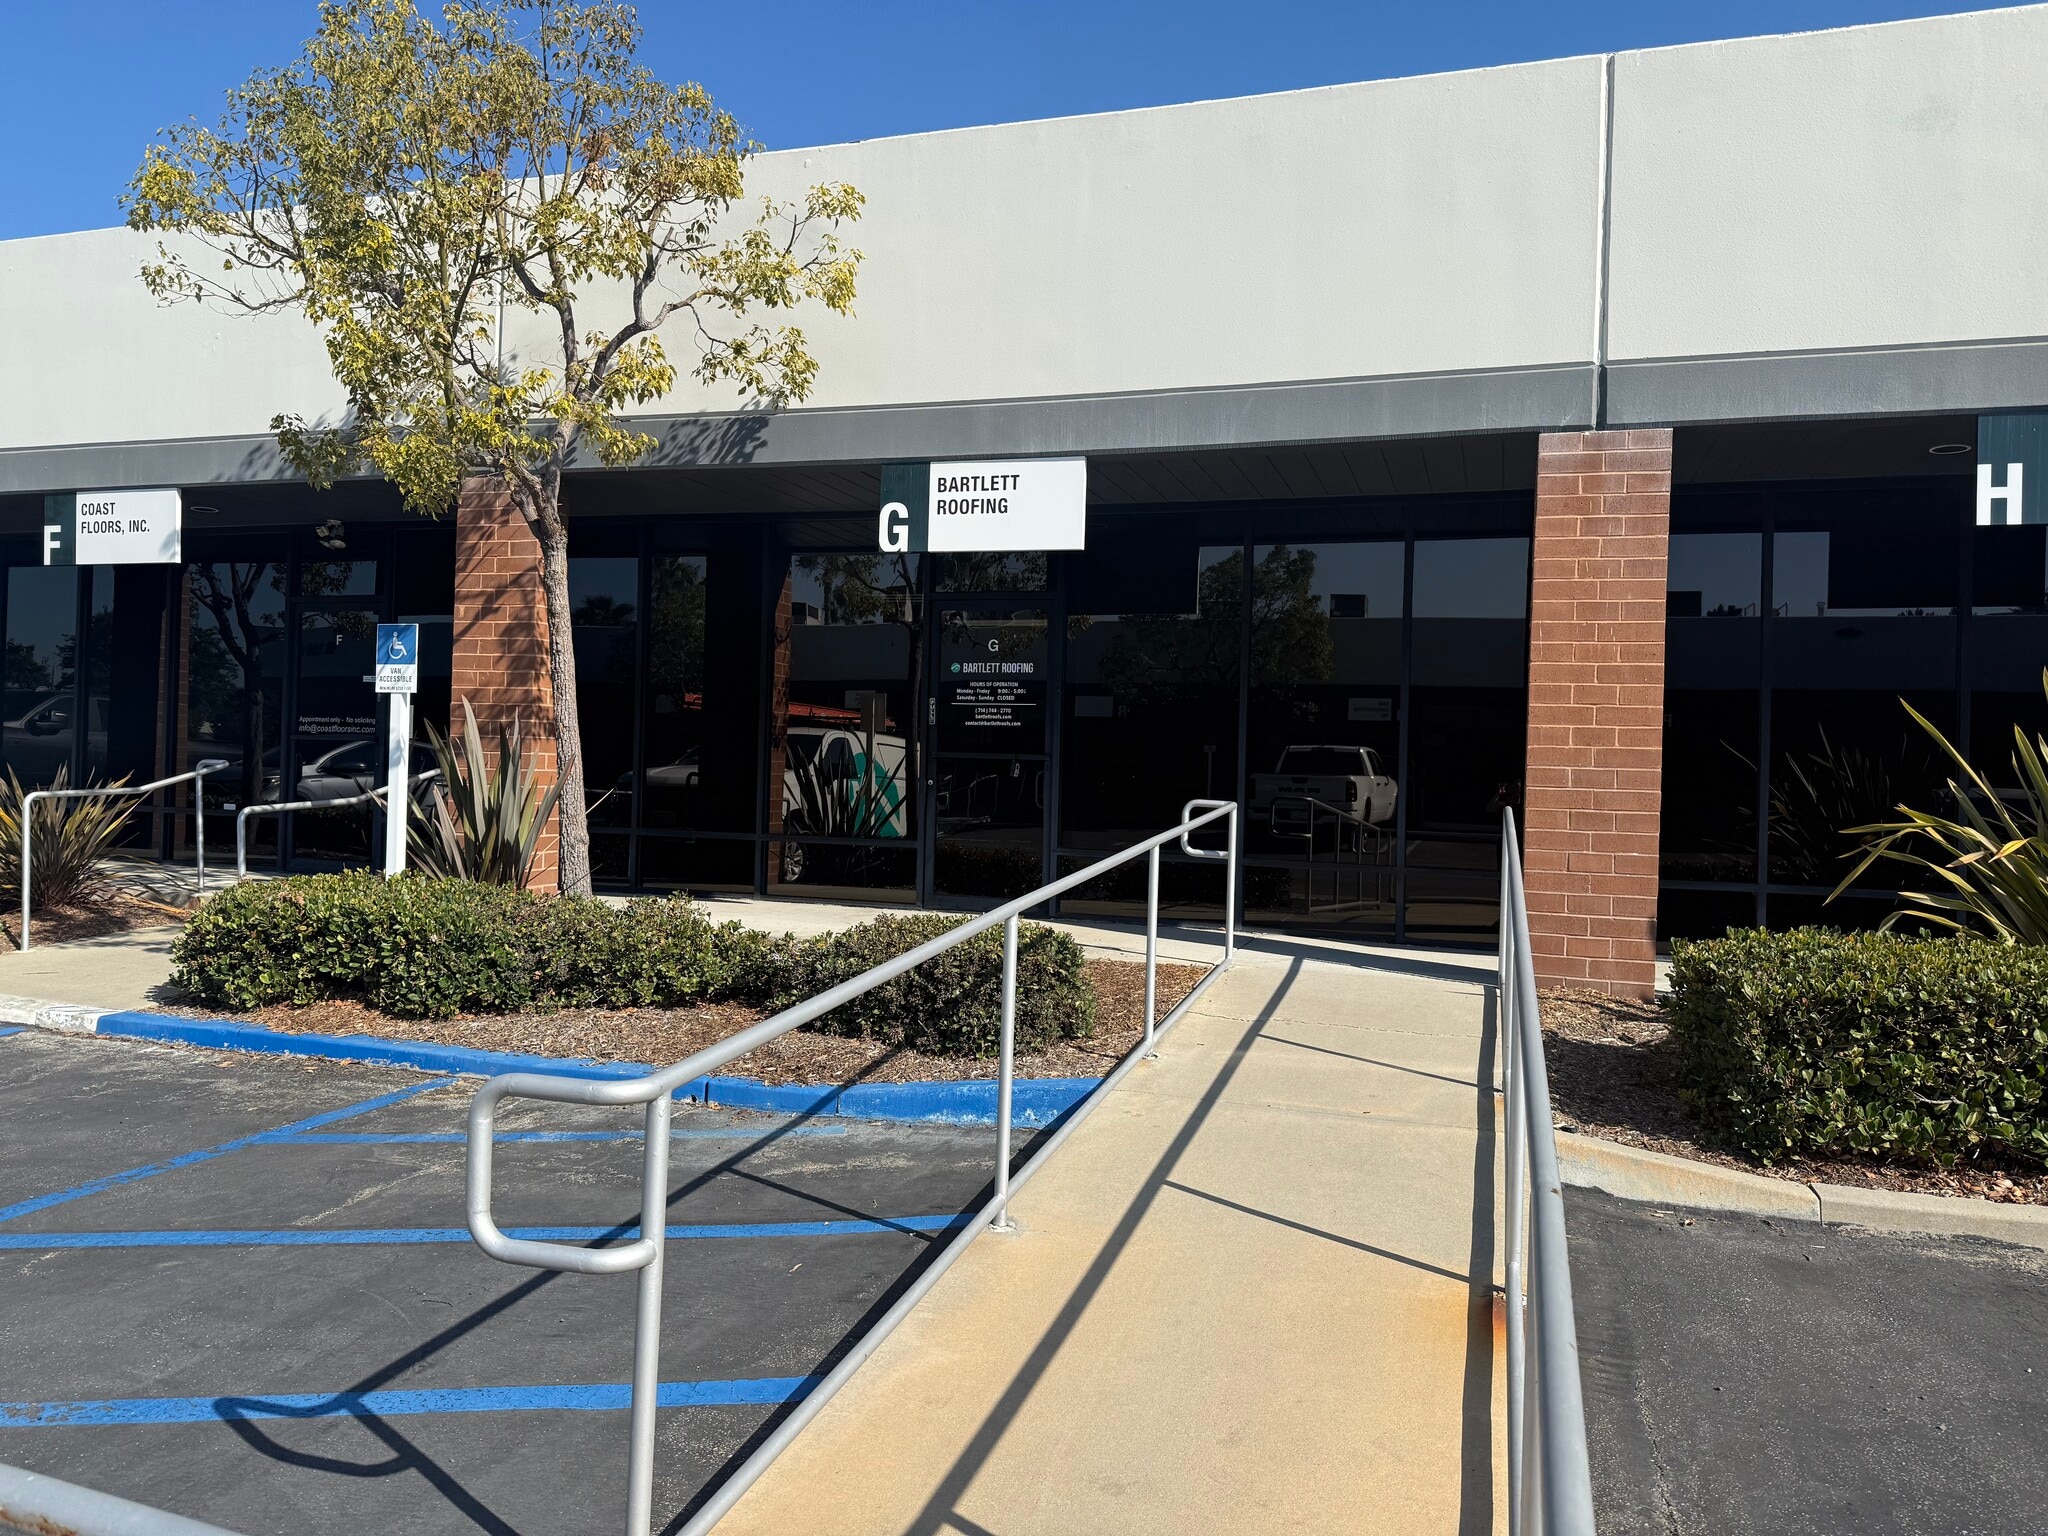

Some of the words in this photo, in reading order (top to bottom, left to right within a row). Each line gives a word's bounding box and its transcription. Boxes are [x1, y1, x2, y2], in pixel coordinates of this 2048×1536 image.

[937, 474, 1020, 493] BARTLETT
[1976, 463, 2023, 525] H
[81, 502, 116, 516] COAST
[937, 497, 1008, 515] ROOFING
[81, 520, 125, 535] FLOORS,
[129, 519, 150, 533] INC.
[878, 502, 909, 552] G
[44, 525, 61, 565] F
[336, 634, 343, 645] F
[988, 639, 999, 652] G
[963, 662, 1000, 673] BARTLETT
[1001, 662, 1034, 673] ROOFING
[379, 675, 413, 683] ACCESSIBLE
[298, 724, 376, 734] info@coastfloorsinc.com
